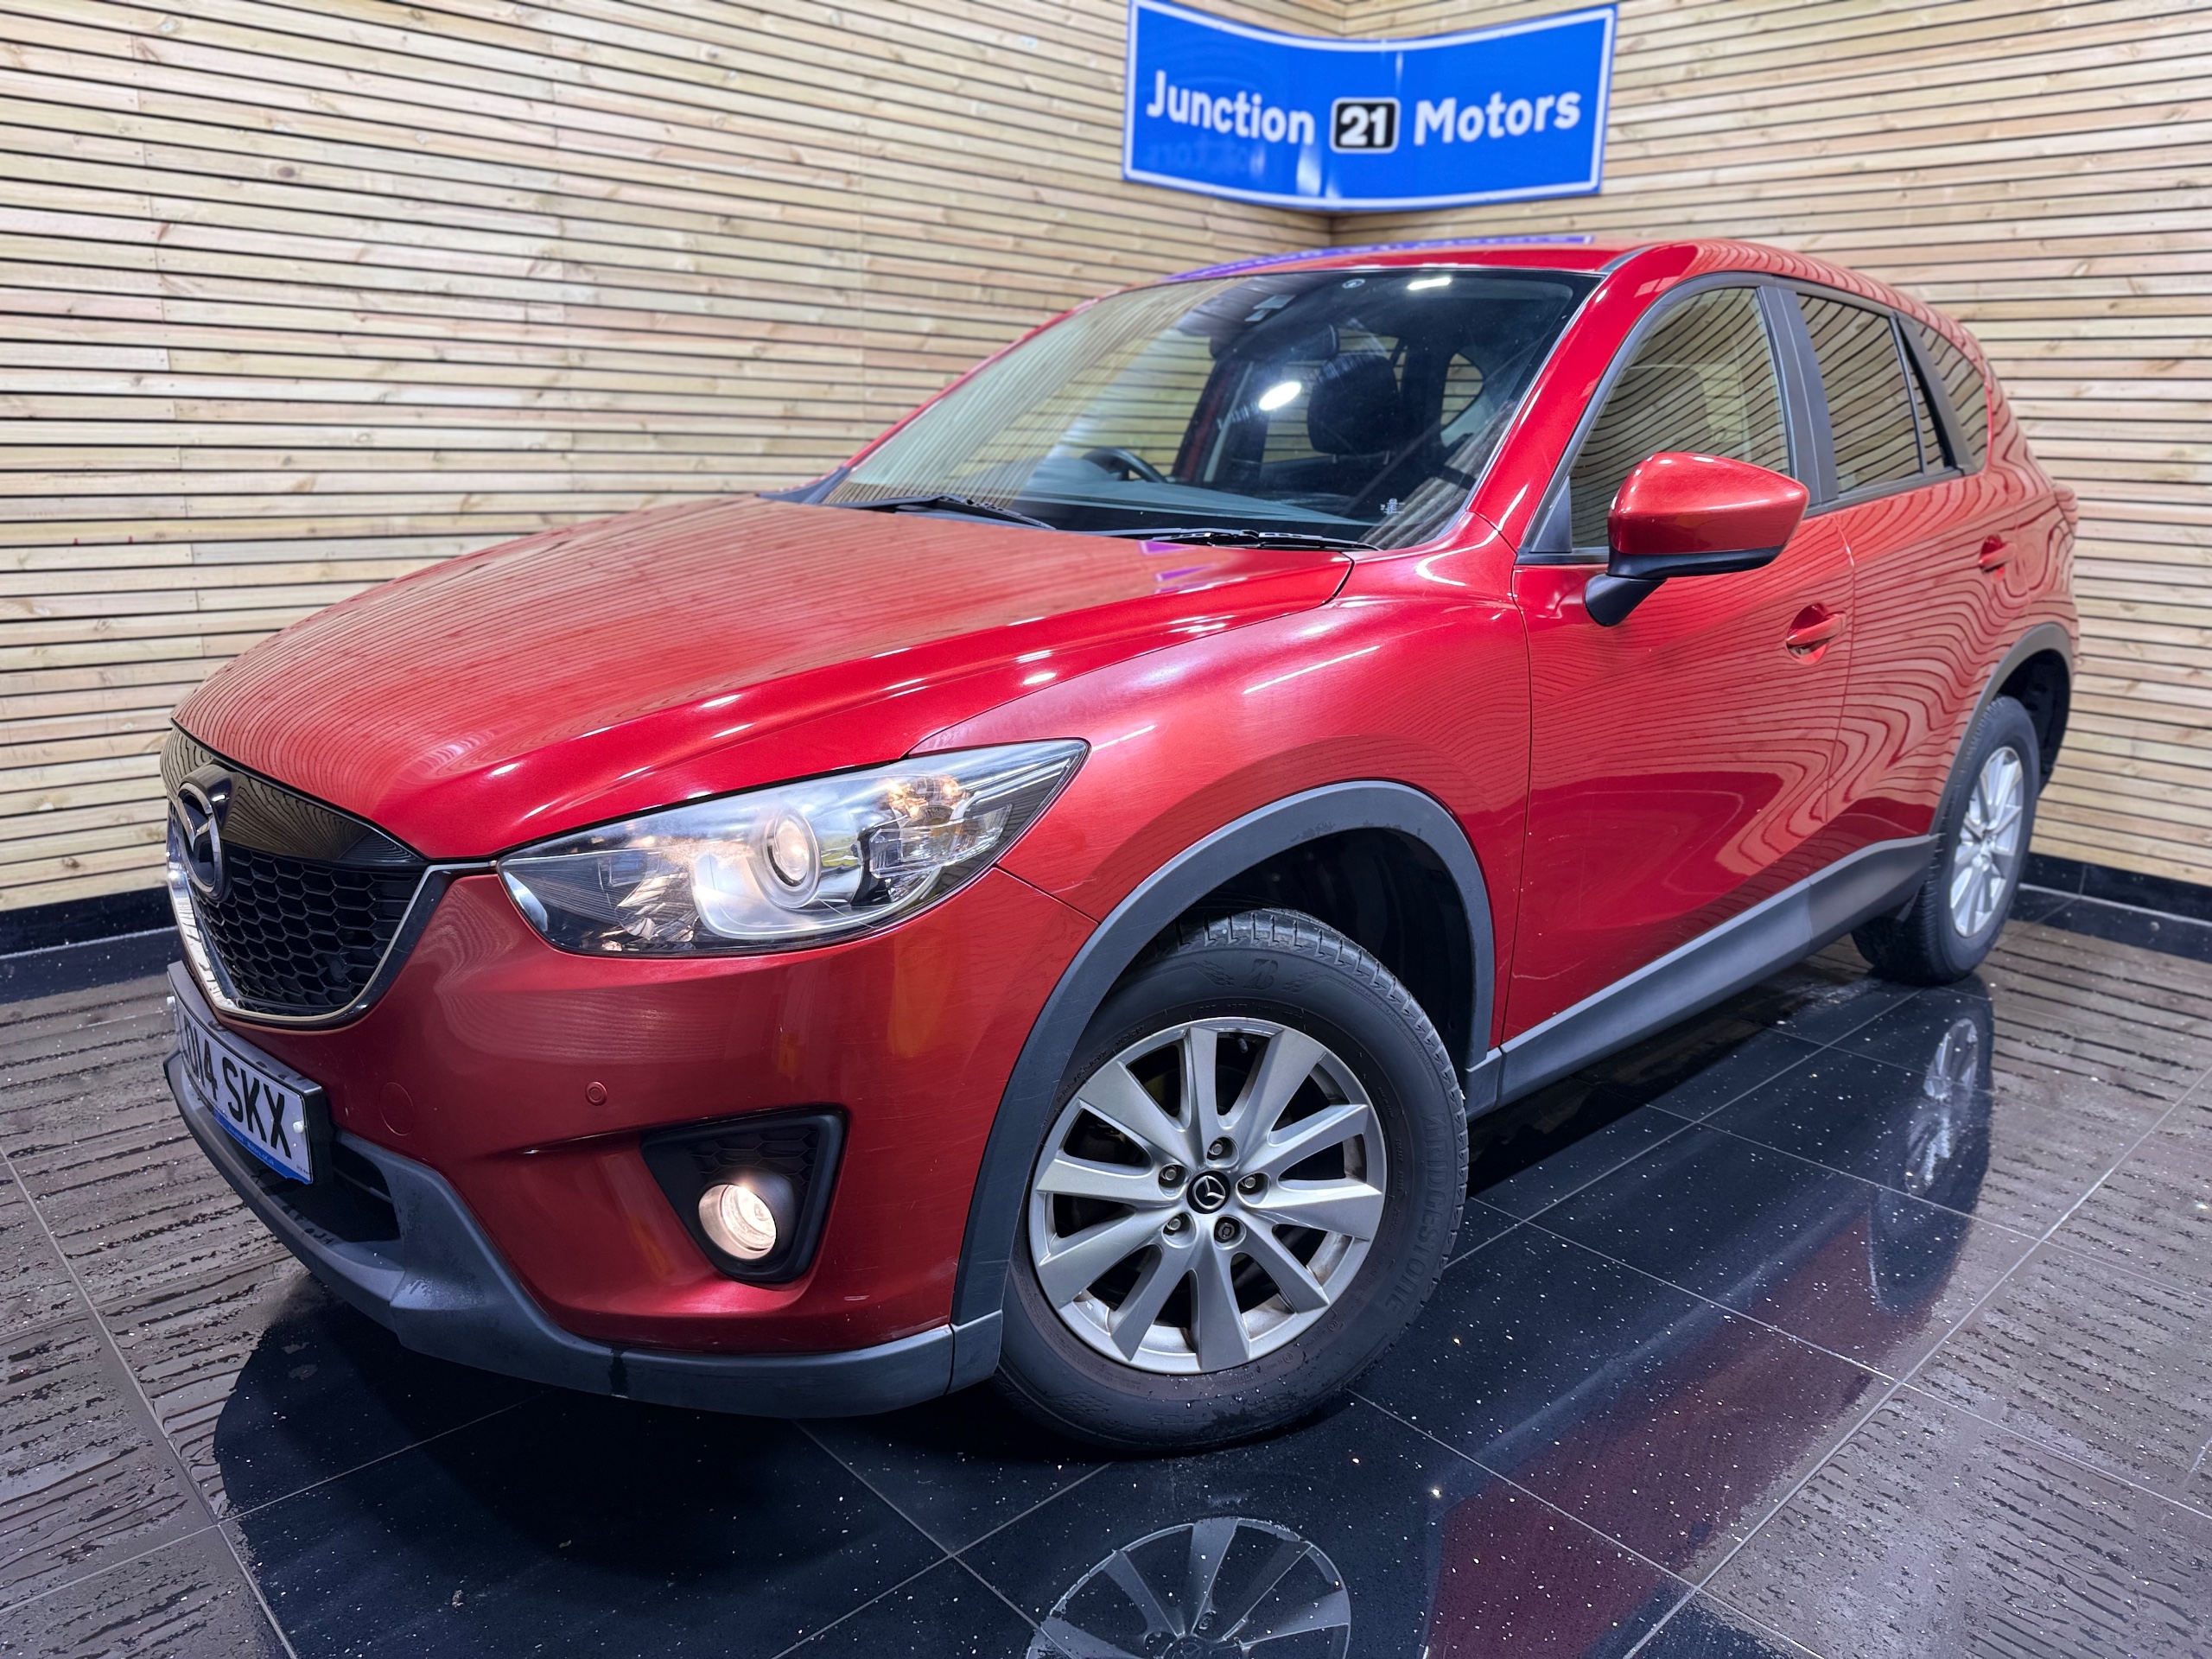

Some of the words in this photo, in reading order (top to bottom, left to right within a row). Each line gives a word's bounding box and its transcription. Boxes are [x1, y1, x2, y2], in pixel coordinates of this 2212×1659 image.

[1147, 70, 1315, 145] Junction
[1339, 105, 1388, 146] 21
[1414, 92, 1581, 145] Motors
[222, 1056, 292, 1159] SKX
